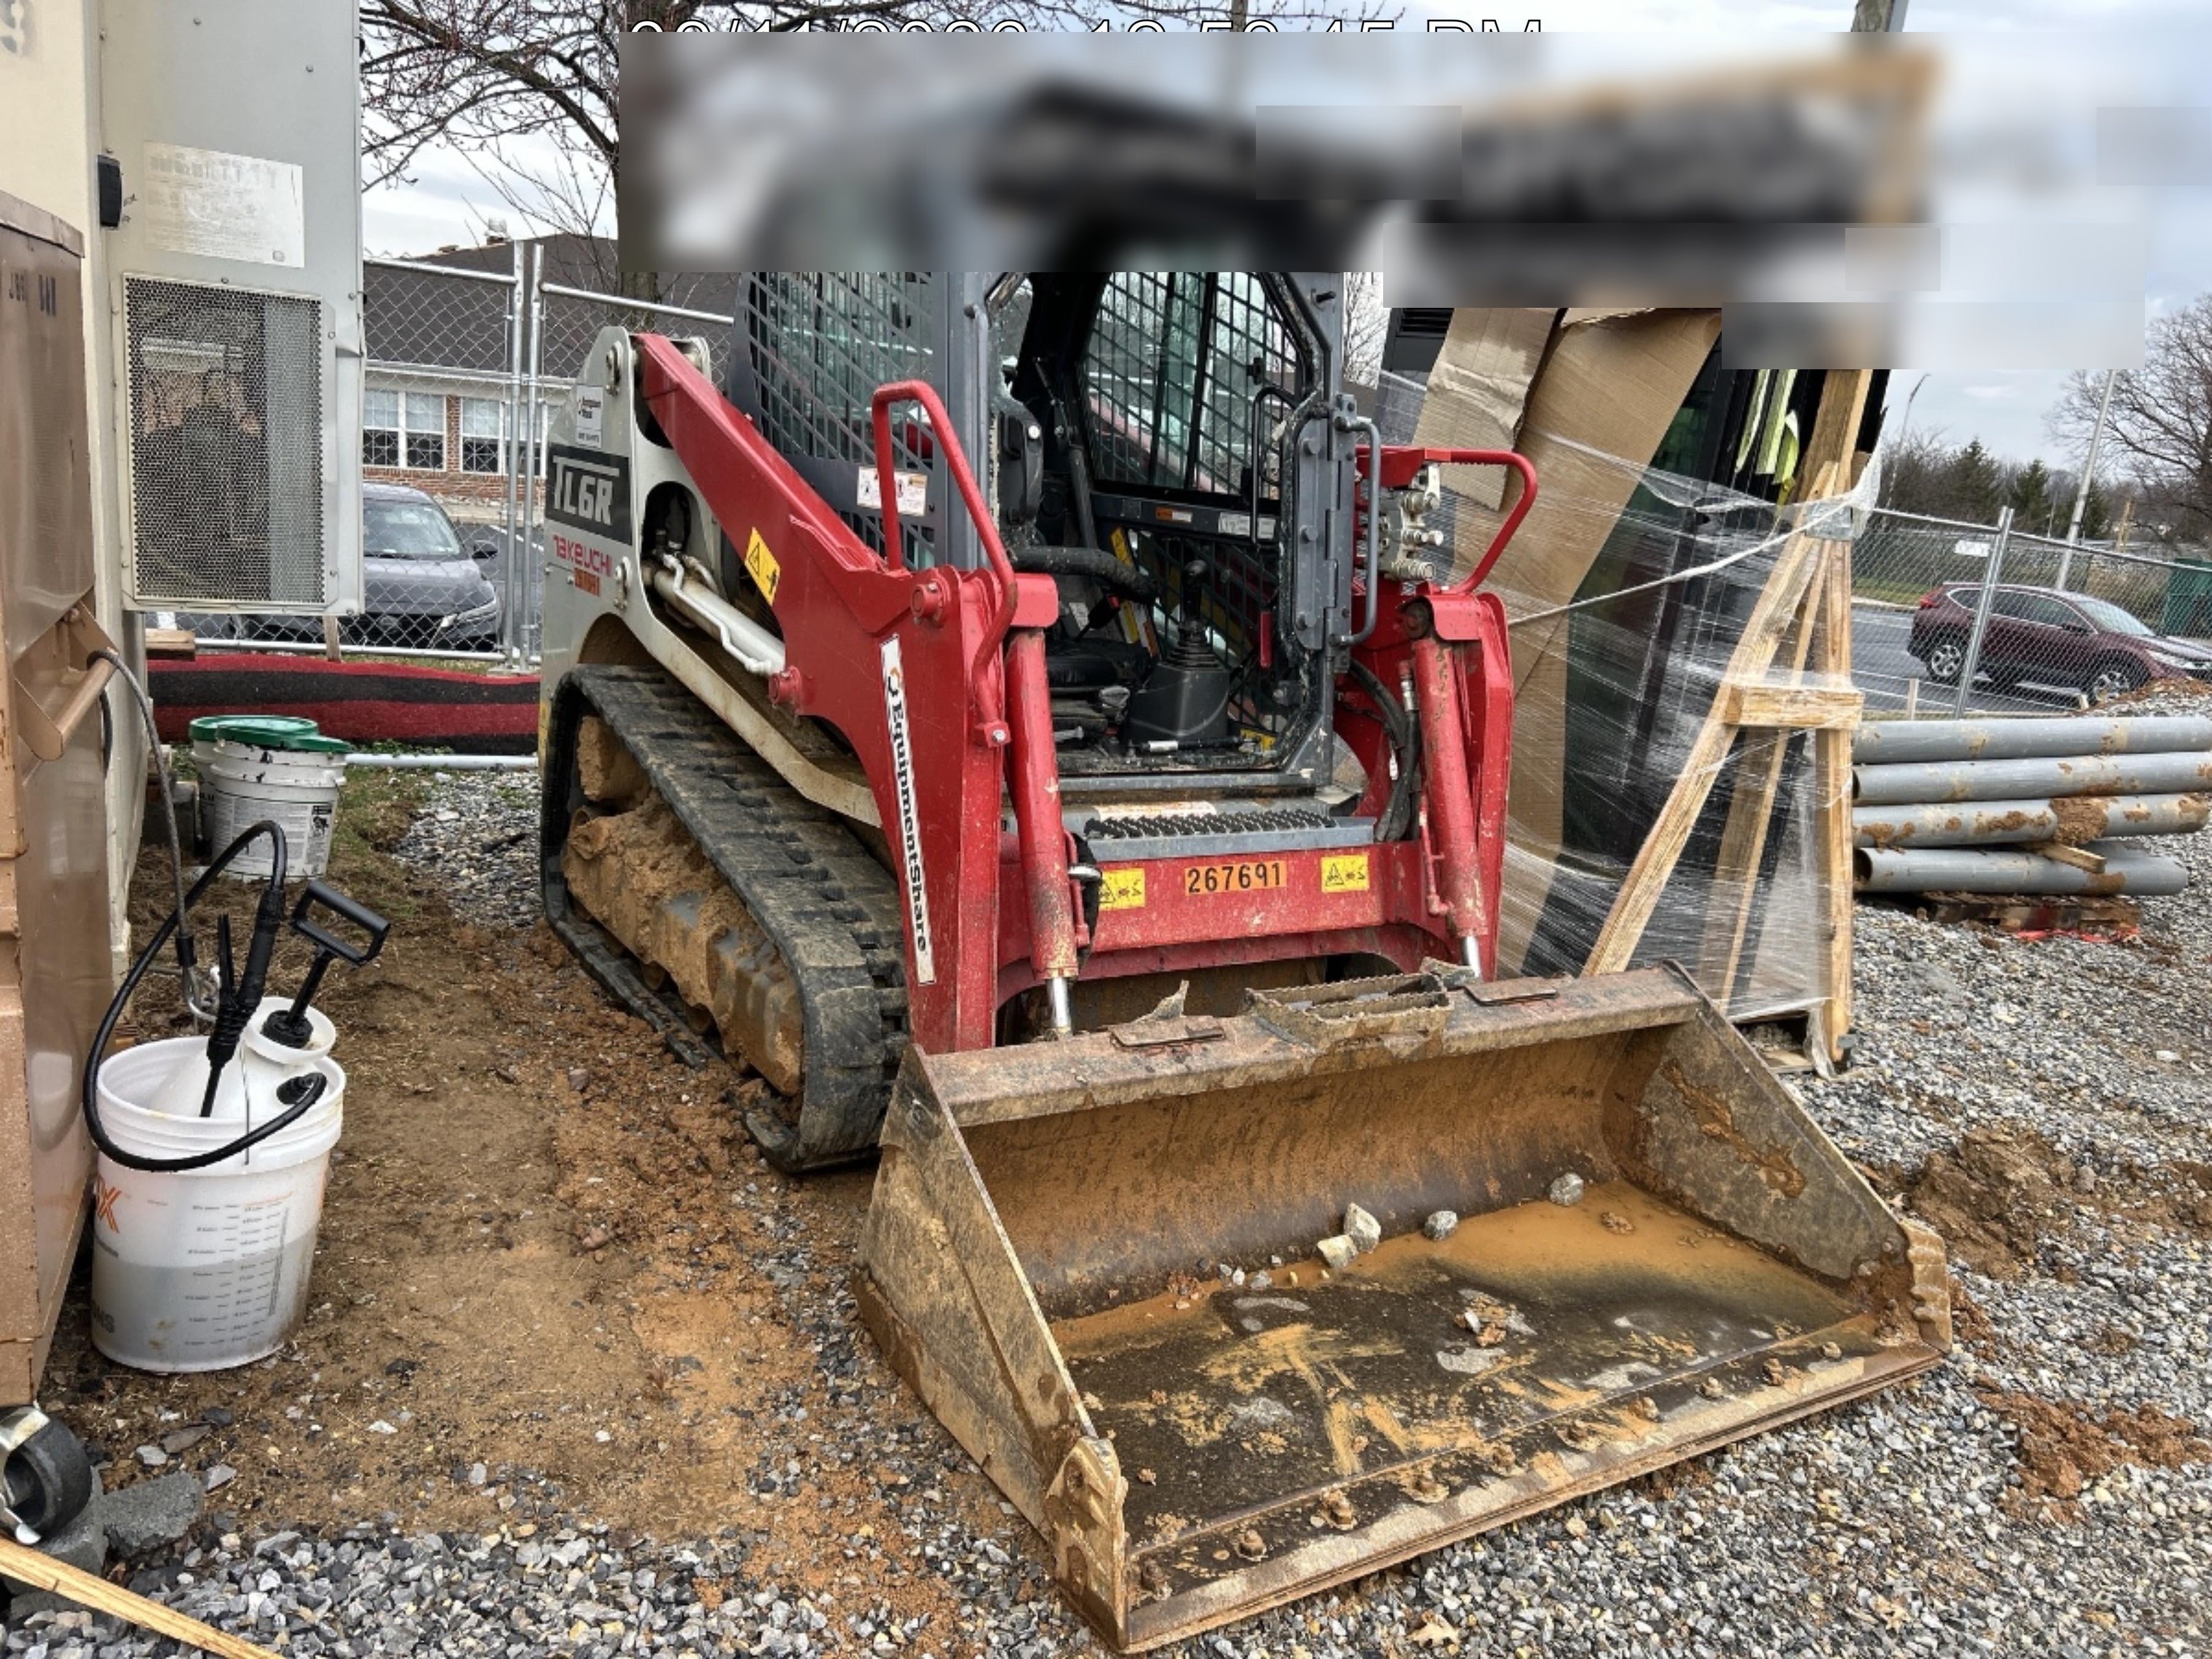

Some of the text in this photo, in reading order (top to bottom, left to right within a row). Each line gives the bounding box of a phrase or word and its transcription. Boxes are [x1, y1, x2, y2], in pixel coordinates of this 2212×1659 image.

[552, 455, 619, 526] TL6R
[892, 700, 927, 951] EquipmentShare
[1187, 862, 1281, 893] 267691
